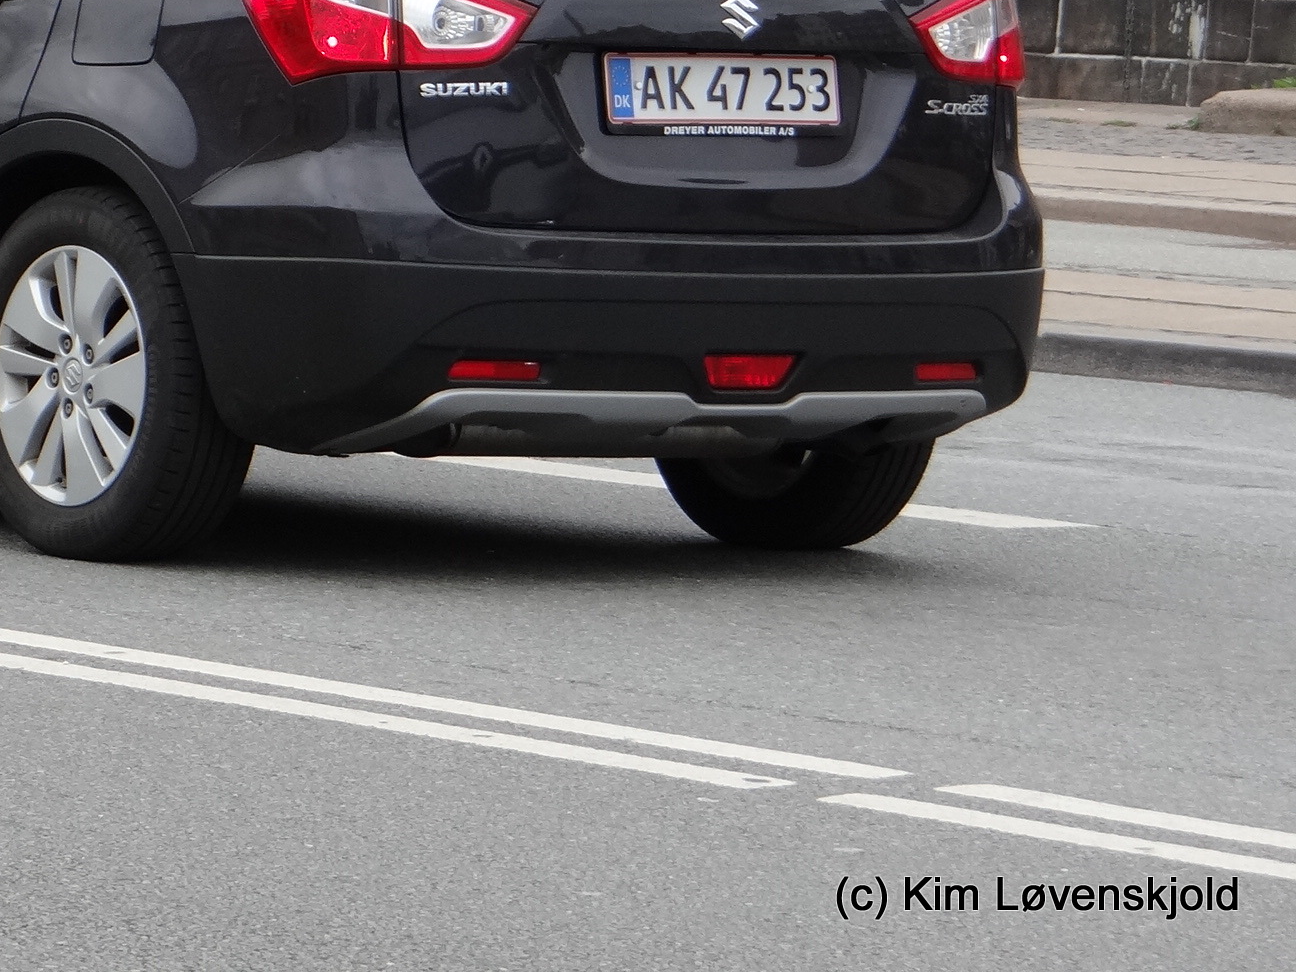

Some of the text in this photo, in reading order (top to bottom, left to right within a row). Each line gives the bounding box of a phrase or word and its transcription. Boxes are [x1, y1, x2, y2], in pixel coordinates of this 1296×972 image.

[419, 81, 509, 98] SUZUKI
[639, 65, 832, 113] AK 47 253
[614, 94, 631, 109] DK
[663, 125, 795, 136] DREYER AUTOMOBILER A/S
